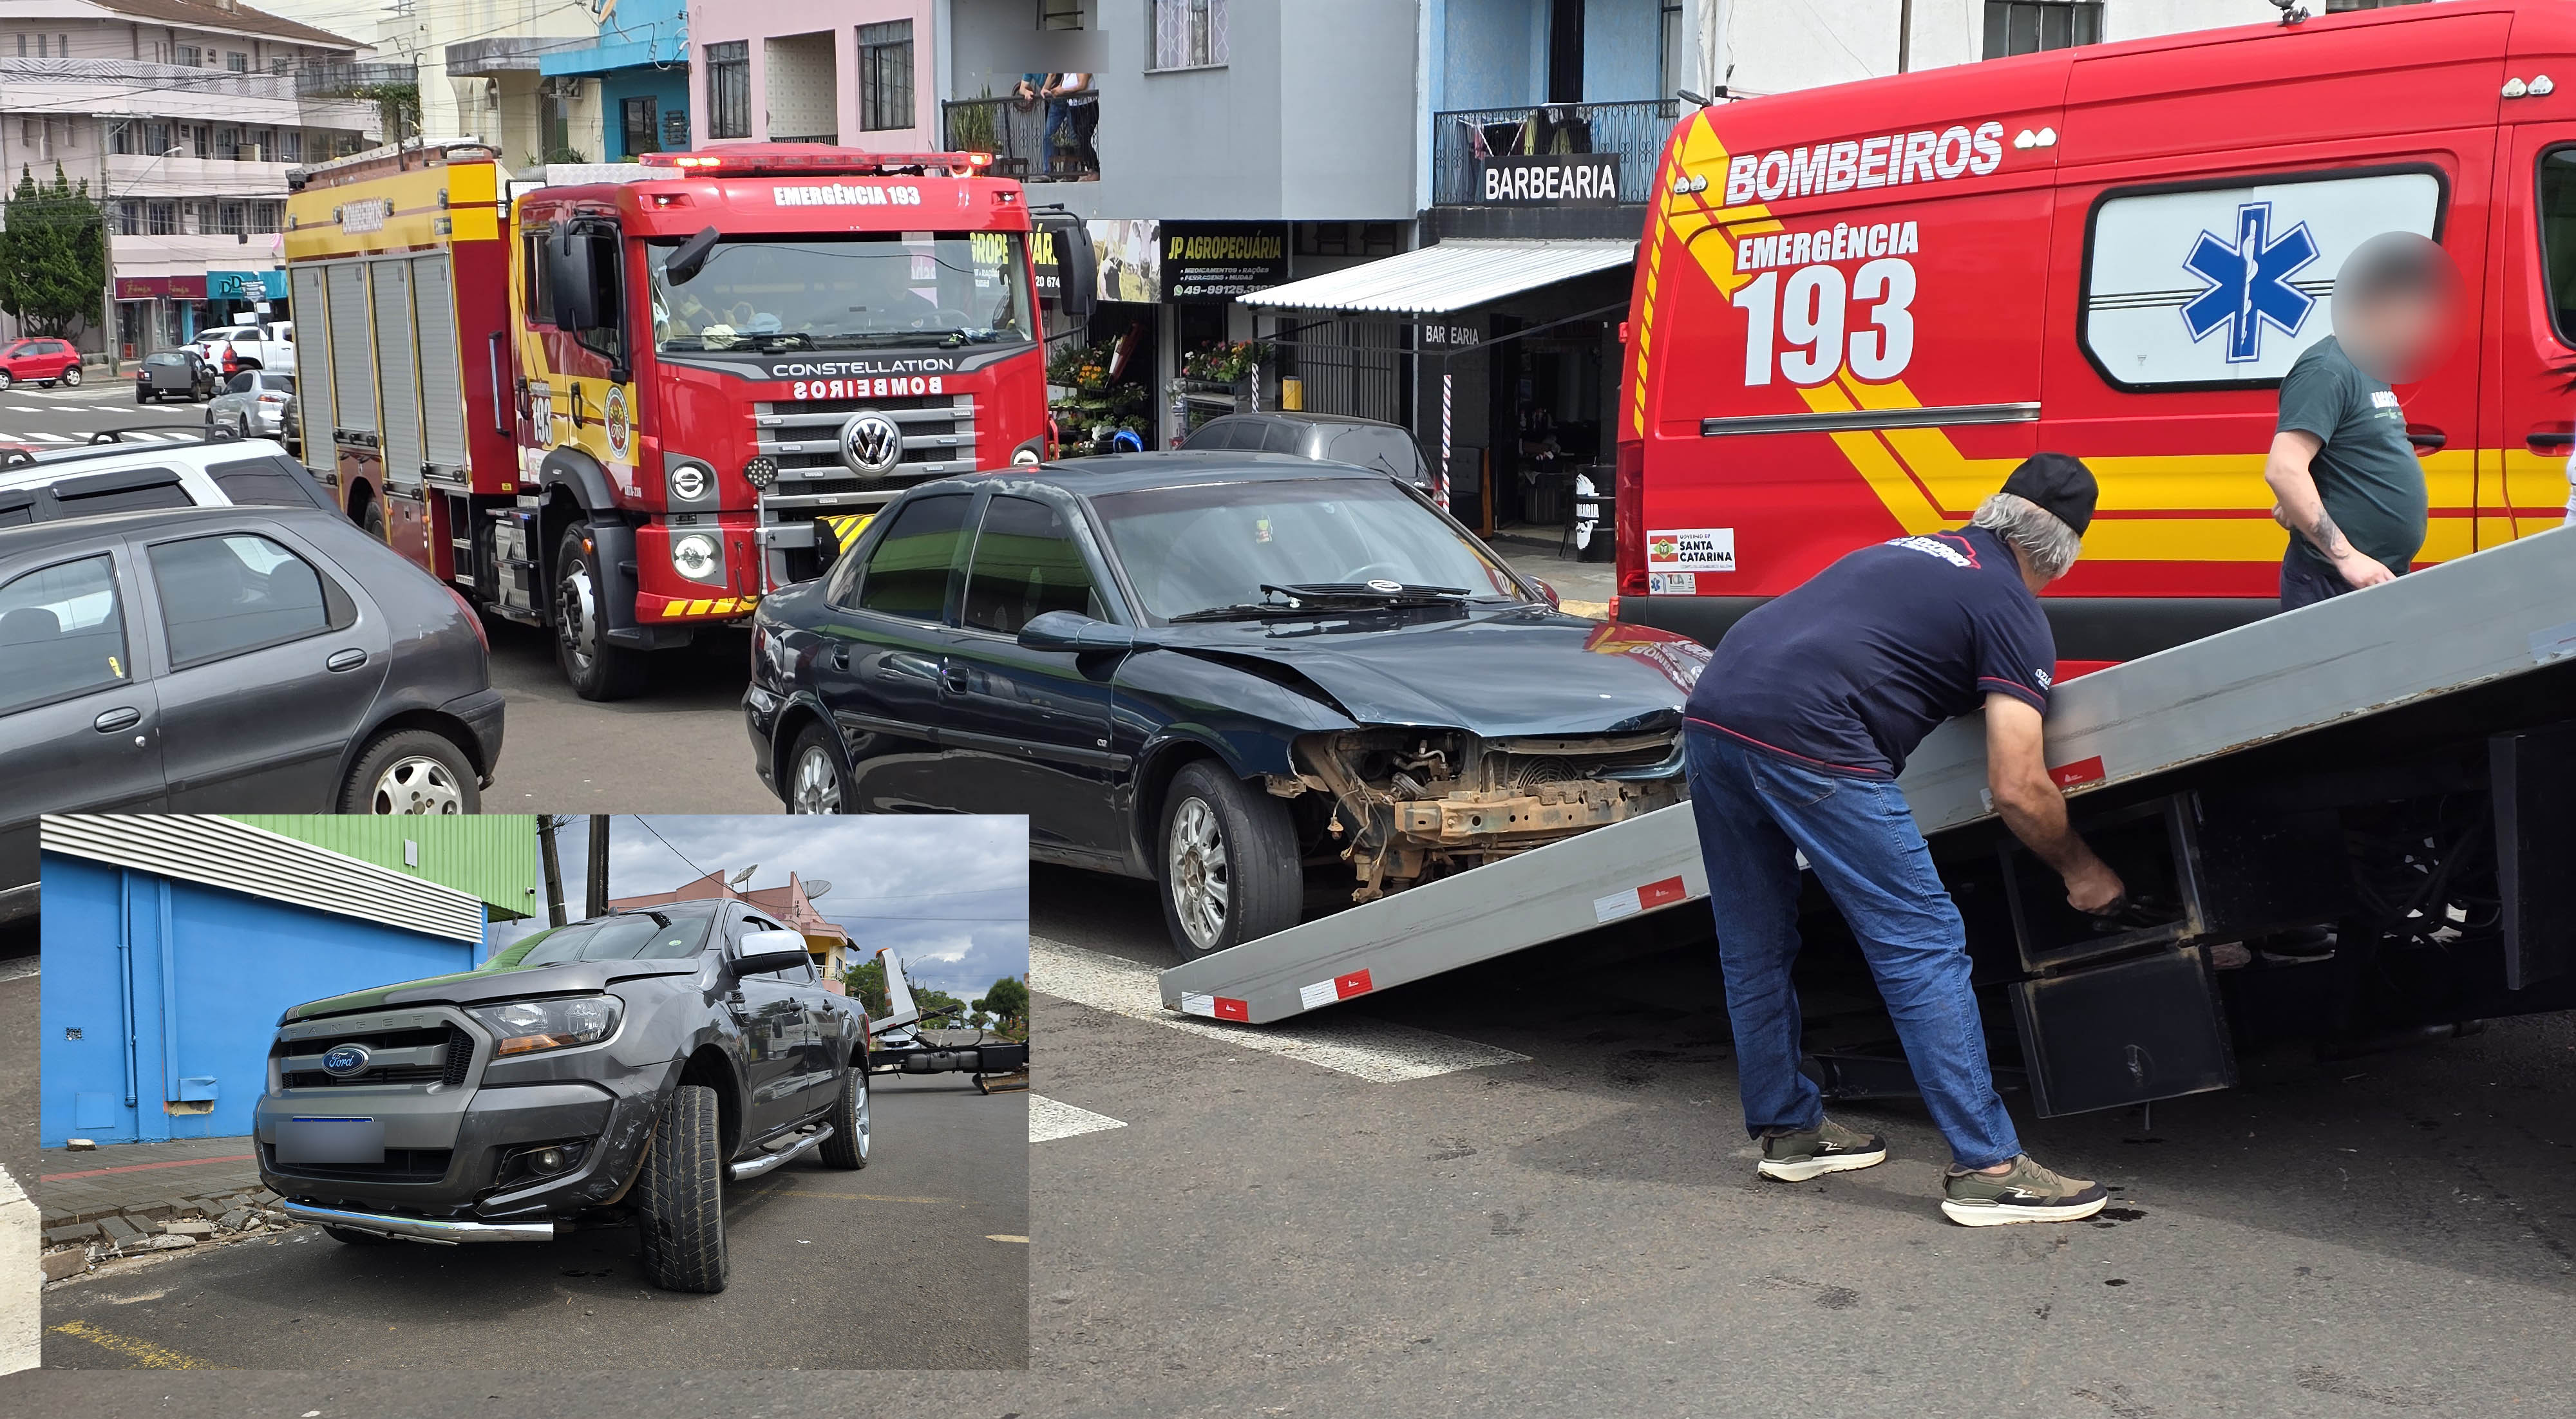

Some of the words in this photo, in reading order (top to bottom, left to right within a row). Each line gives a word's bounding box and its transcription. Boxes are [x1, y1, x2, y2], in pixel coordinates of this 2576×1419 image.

[1726, 122, 2003, 205] BOMBEIROS
[773, 183, 887, 206] EMERGÊNCIA
[887, 185, 921, 205] 193
[1486, 164, 1616, 200] BARBEARIA
[1168, 236, 1184, 259] JP
[1185, 230, 1281, 259] AGROPECUÁRIA
[1737, 221, 1918, 270] EMERGÊNCIA
[1426, 325, 1479, 344] BAREARIA
[1733, 258, 1917, 386] 193
[772, 358, 954, 377] CONSTELLATION
[532, 397, 553, 444] 193
[1680, 541, 1714, 551] SANTA
[1680, 551, 1732, 563] CATARINA
[329, 1051, 354, 1068] Ford
